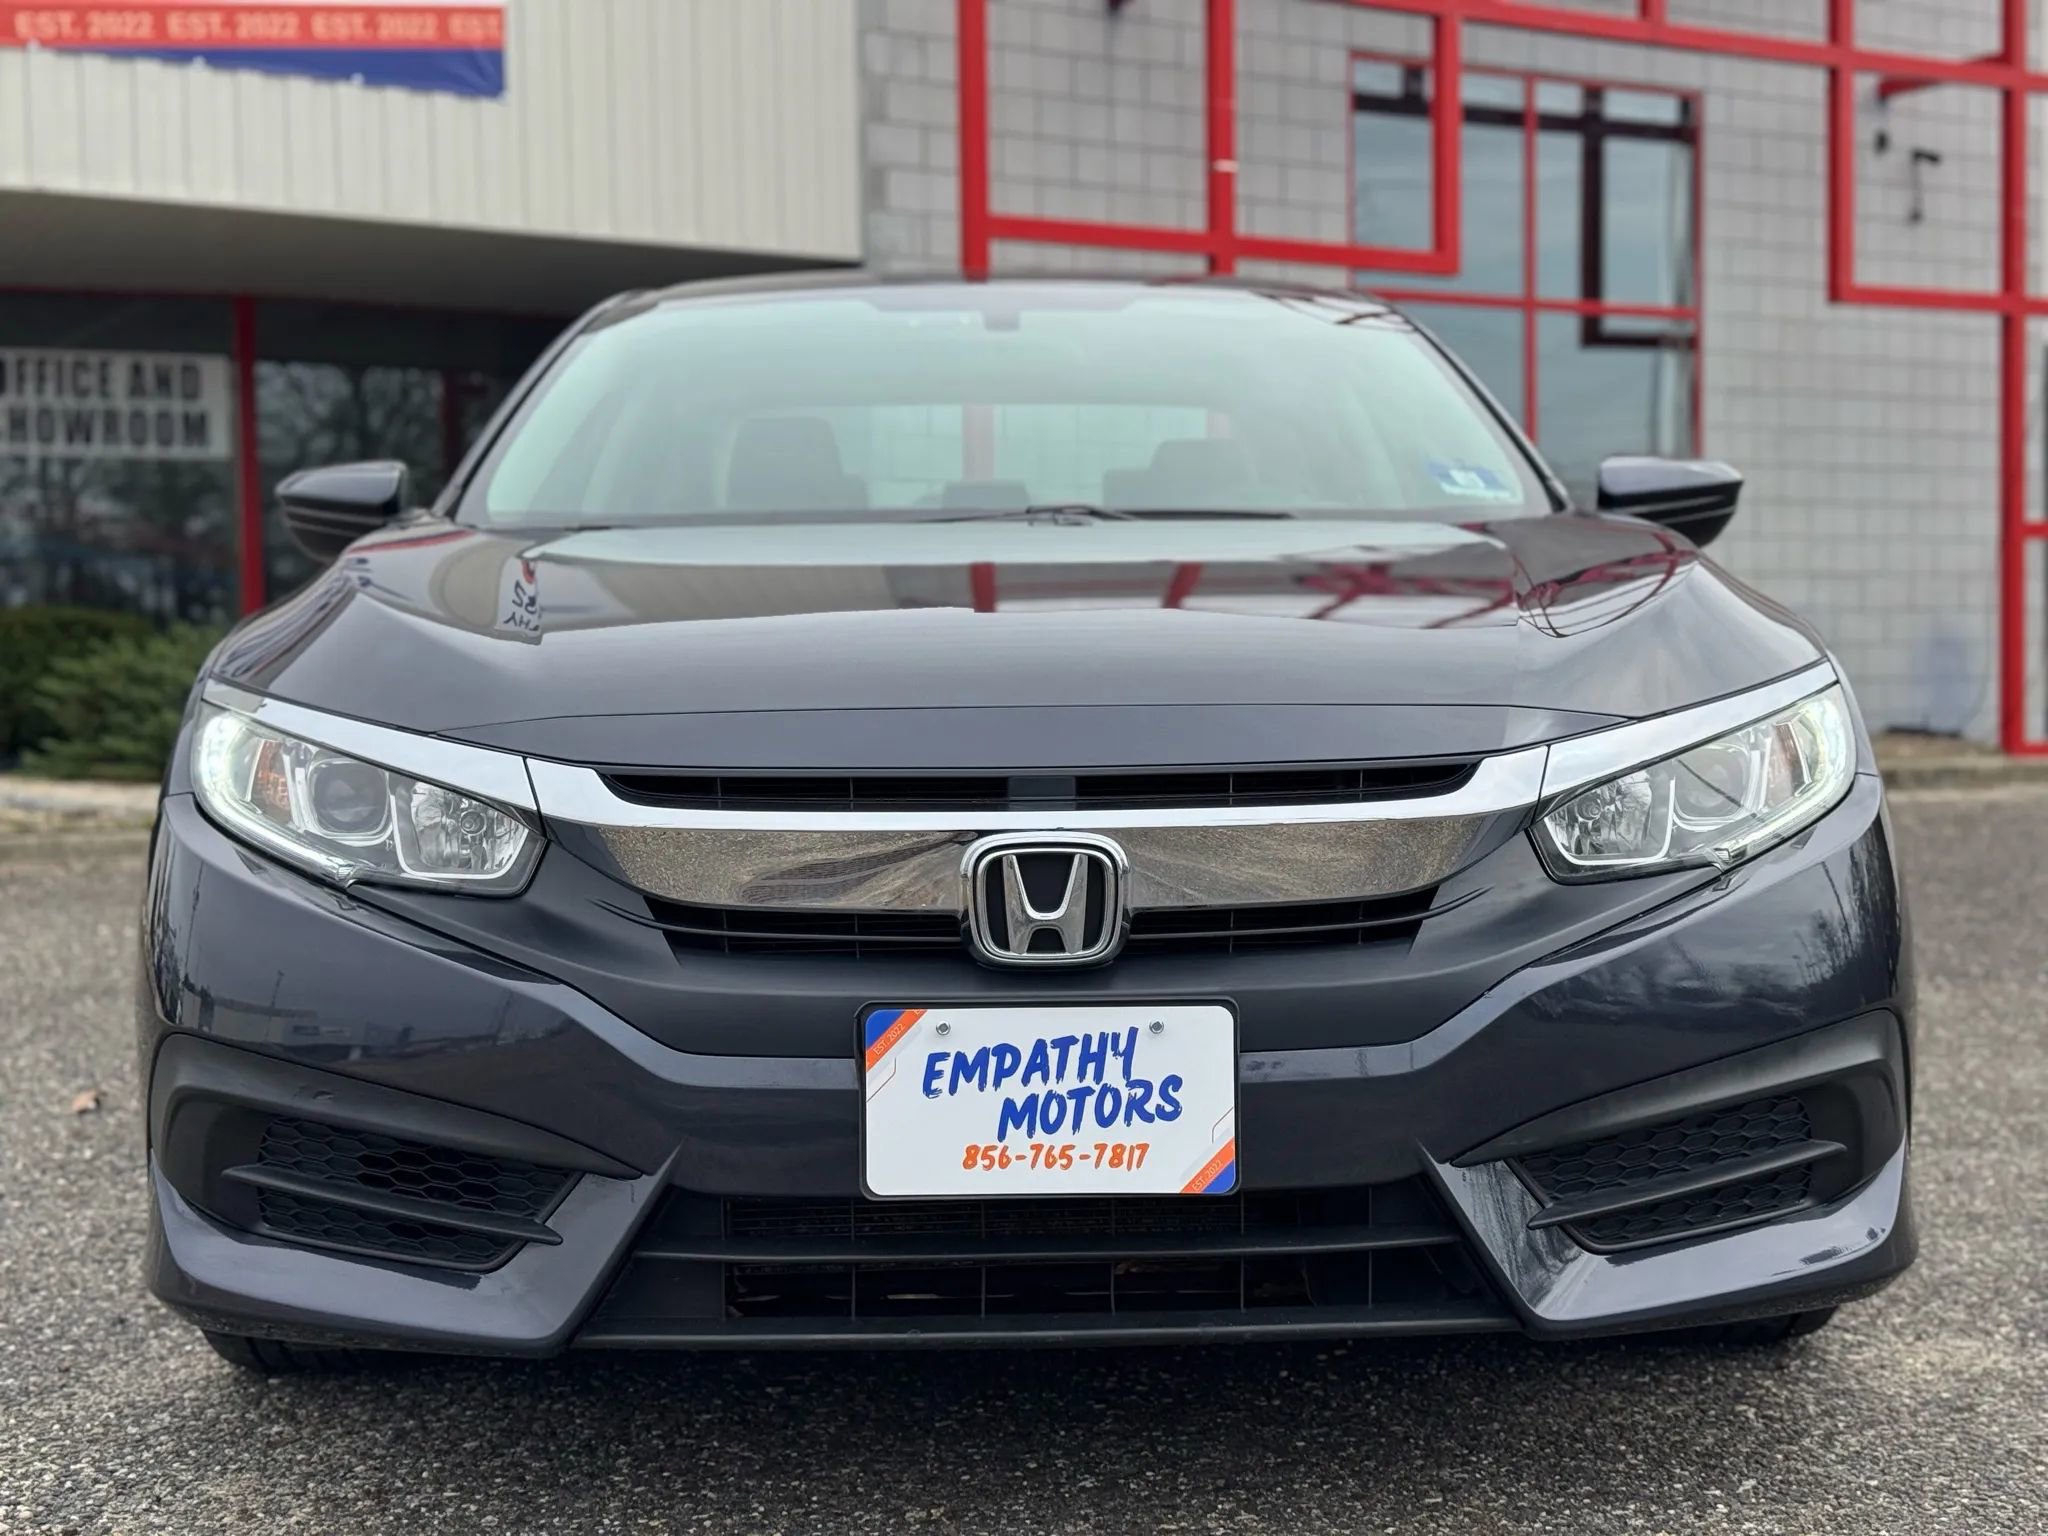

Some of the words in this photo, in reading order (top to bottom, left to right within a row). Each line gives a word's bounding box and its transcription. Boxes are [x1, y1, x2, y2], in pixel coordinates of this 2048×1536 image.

[129, 362, 201, 401] AND
[0, 405, 208, 447] HOWROOM
[886, 1023, 906, 1042] 2022
[922, 1026, 1139, 1099] EMPATHY
[997, 1074, 1183, 1143] MOTORS
[962, 1142, 1150, 1171] 856-765-7817
